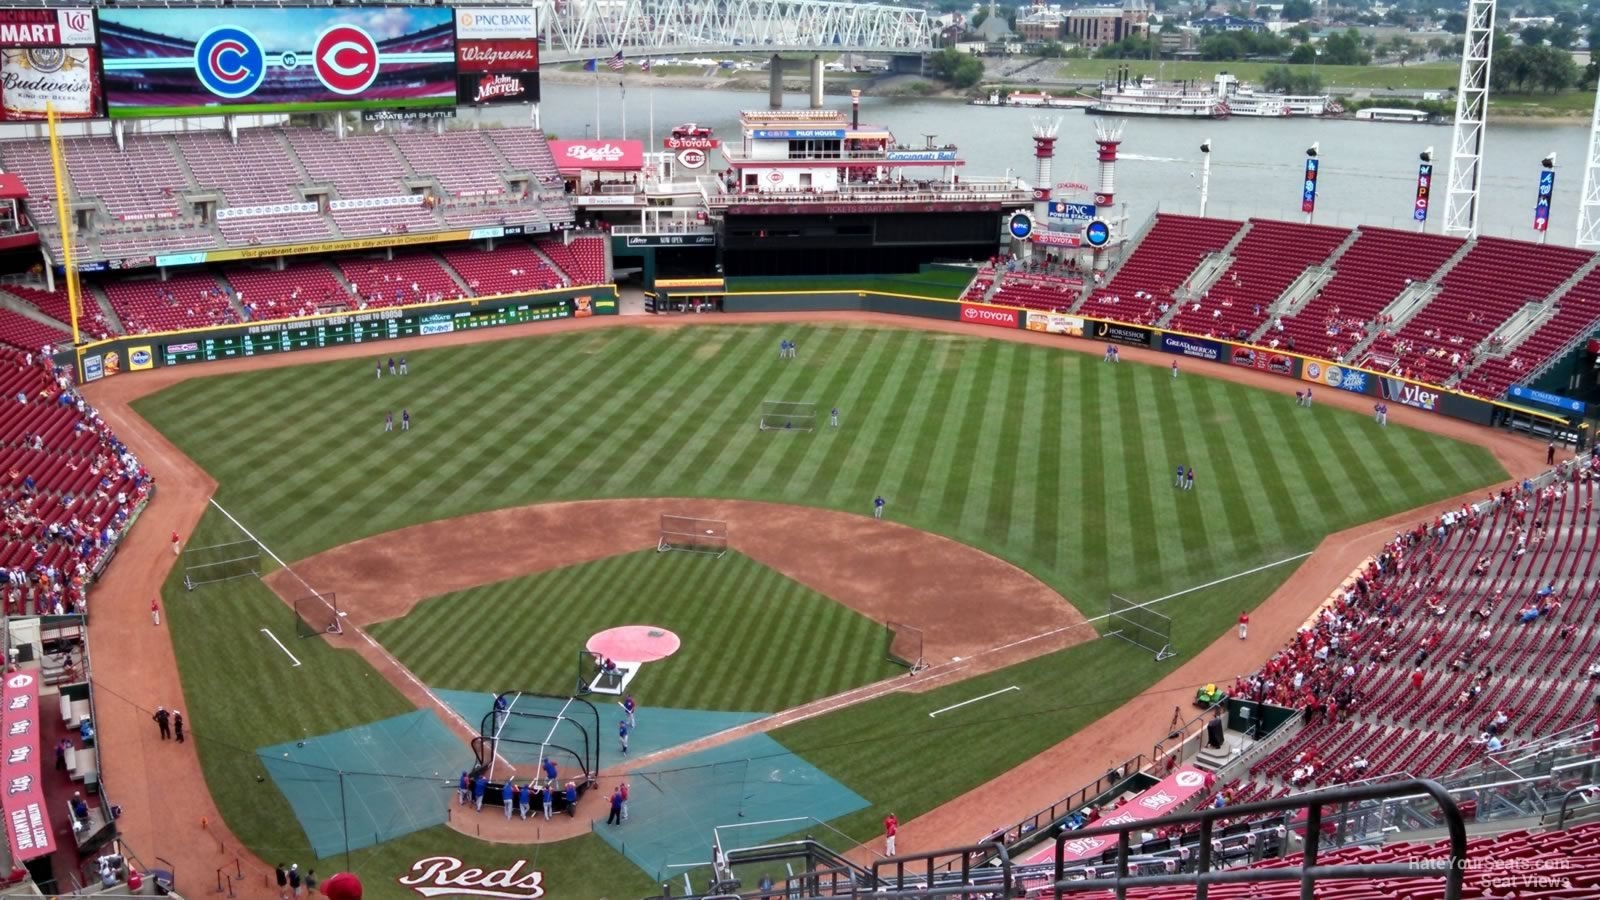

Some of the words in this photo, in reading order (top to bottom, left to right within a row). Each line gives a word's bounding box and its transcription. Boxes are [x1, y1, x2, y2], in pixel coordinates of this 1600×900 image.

[475, 15, 500, 25] PNC
[502, 15, 531, 25] BANK
[1, 24, 55, 42] MART
[461, 46, 534, 64] Walgreens
[0, 72, 90, 92] Budweiser
[492, 74, 511, 84] John
[474, 80, 524, 102] Morrell
[365, 112, 403, 120] ULTIMATE
[566, 144, 624, 160] Reds
[888, 152, 934, 160] Cincinnati
[937, 152, 956, 160] Bell
[1066, 205, 1087, 215] PNC
[978, 311, 1013, 322] TOYOTA
[288, 321, 311, 329] SERVICE
[1109, 328, 1144, 338] HORSESHOE
[1146, 792, 1172, 807] 1990
[28, 803, 42, 828] NATIONAL
[12, 810, 33, 850] CHAMPIONS
[33, 828, 48, 848] LEAGUE
[400, 856, 544, 899] Reds
